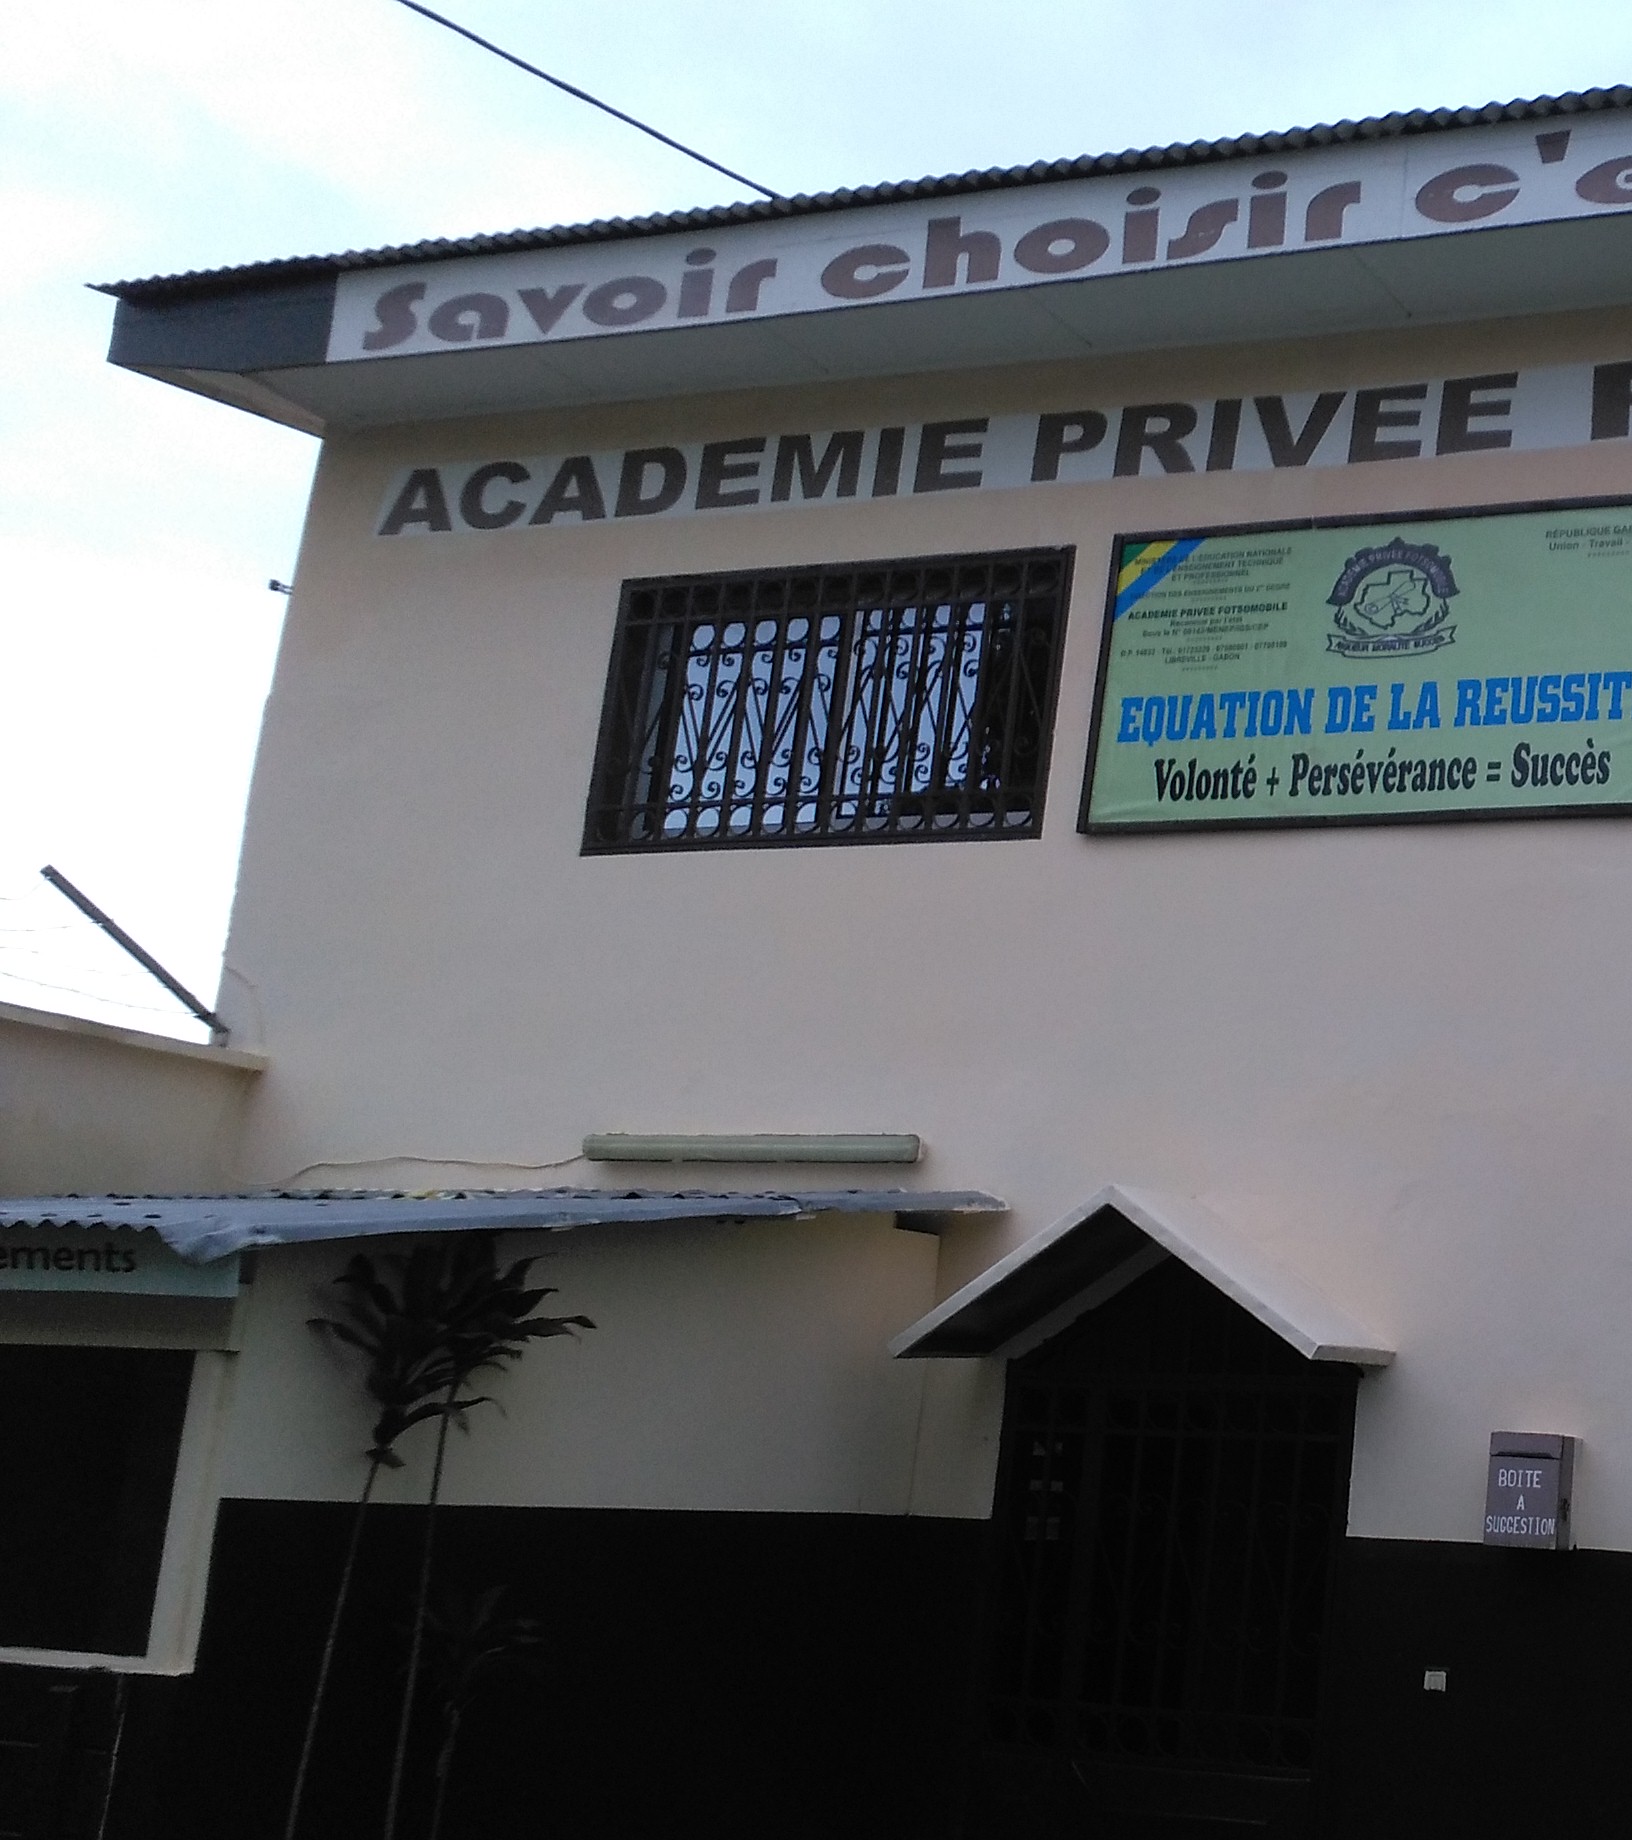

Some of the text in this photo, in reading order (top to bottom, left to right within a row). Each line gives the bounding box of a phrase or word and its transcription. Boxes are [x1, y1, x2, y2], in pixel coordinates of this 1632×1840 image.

[362, 247, 777, 351] Savoir
[820, 170, 1361, 300] choisir
[378, 417, 990, 536] ACADEMIE
[1031, 372, 1519, 482] PRIVEE
[1549, 541, 1579, 551] Union
[1589, 538, 1623, 548] Travail
[1128, 602, 1288, 620] ACADEMIE PRIVEE FOTSOMOBILE
[1117, 689, 1314, 747] EQUATION
[1325, 685, 1378, 734] DE
[1387, 681, 1442, 730] LA
[1153, 744, 1258, 802] Volonté
[1290, 747, 1477, 798] Persévérance
[1511, 738, 1612, 788] Succès
[1498, 1468, 1542, 1488] BOITE
[1516, 1494, 1525, 1511] A
